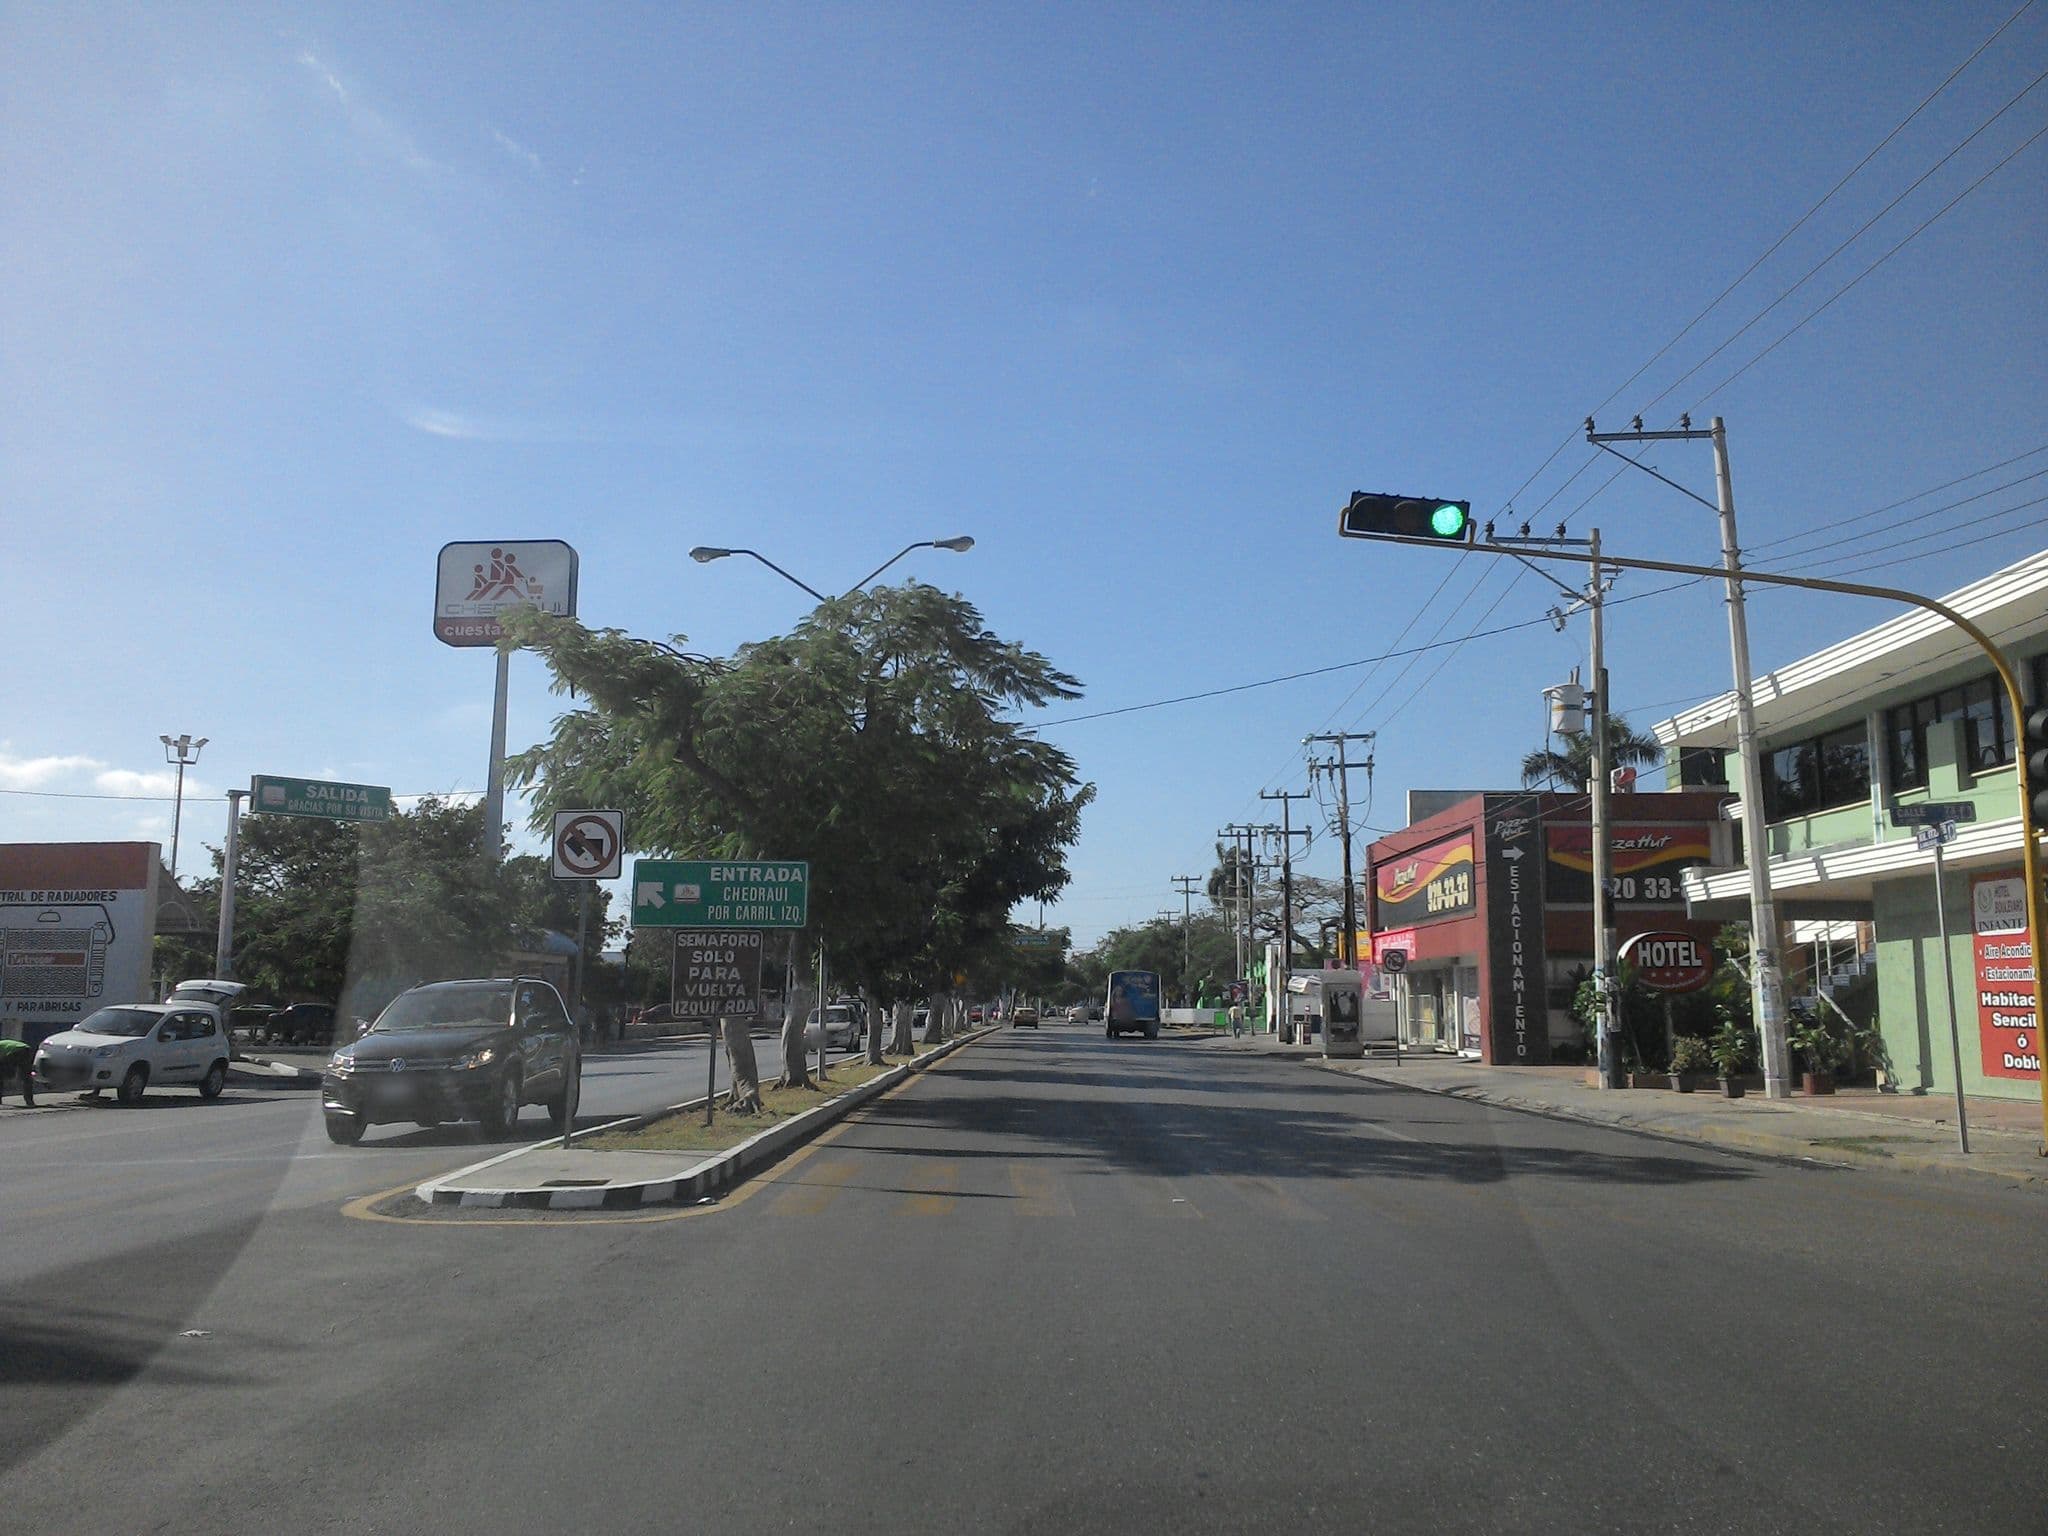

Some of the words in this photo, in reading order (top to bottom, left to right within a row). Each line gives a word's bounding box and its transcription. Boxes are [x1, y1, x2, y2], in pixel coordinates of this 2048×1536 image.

[305, 784, 369, 803] SALIDA
[288, 799, 323, 814] GRACIAS
[326, 802, 342, 816] POR
[346, 804, 357, 816] SU
[710, 866, 803, 883] ENTRADA
[723, 886, 788, 902] CHEDRAUI
[1643, 877, 1686, 899] 33-
[31, 891, 46, 902] DE
[47, 891, 118, 902] RADIADORES
[707, 906, 730, 921] POR
[735, 906, 776, 921] CARRIL
[678, 933, 760, 948] SEMAFORO
[691, 950, 735, 964] SOLO
[1509, 866, 1527, 1056] ESTACIONAMIENTO
[1637, 941, 1703, 968] HOTEL
[688, 966, 741, 981] PARA
[685, 984, 746, 998] VUELTA
[6, 1002, 12, 1012] Y
[17, 1001, 83, 1012] PARABRISAS
[675, 999, 756, 1015] IZQUIRDA
